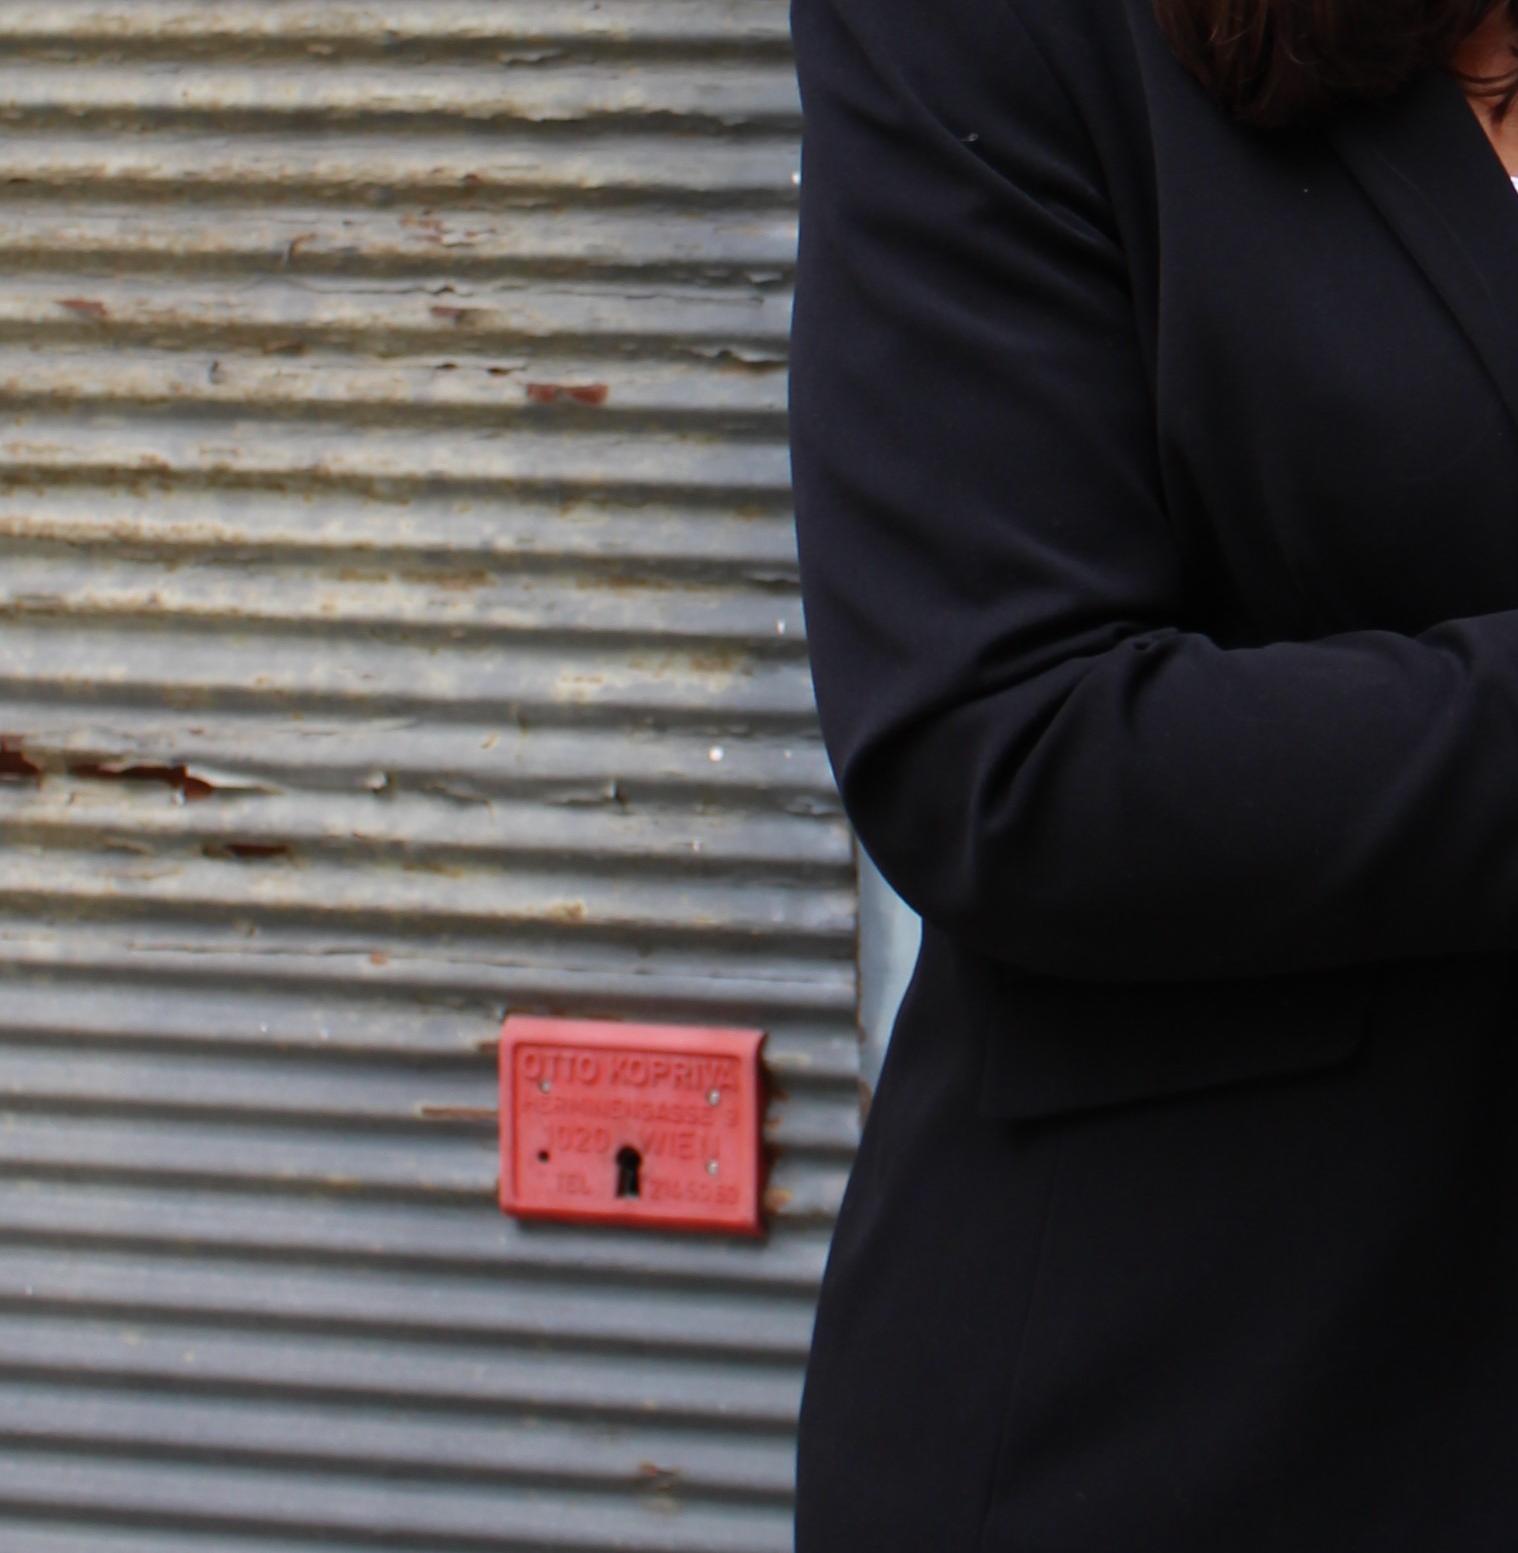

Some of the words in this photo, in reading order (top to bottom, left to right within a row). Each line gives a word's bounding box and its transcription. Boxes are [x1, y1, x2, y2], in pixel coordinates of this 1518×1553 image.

[522, 1049, 600, 1086] OTTO
[608, 1053, 739, 1093] KOPRIVA
[543, 1124, 612, 1155] 1020
[639, 1129, 721, 1162] WIEN
